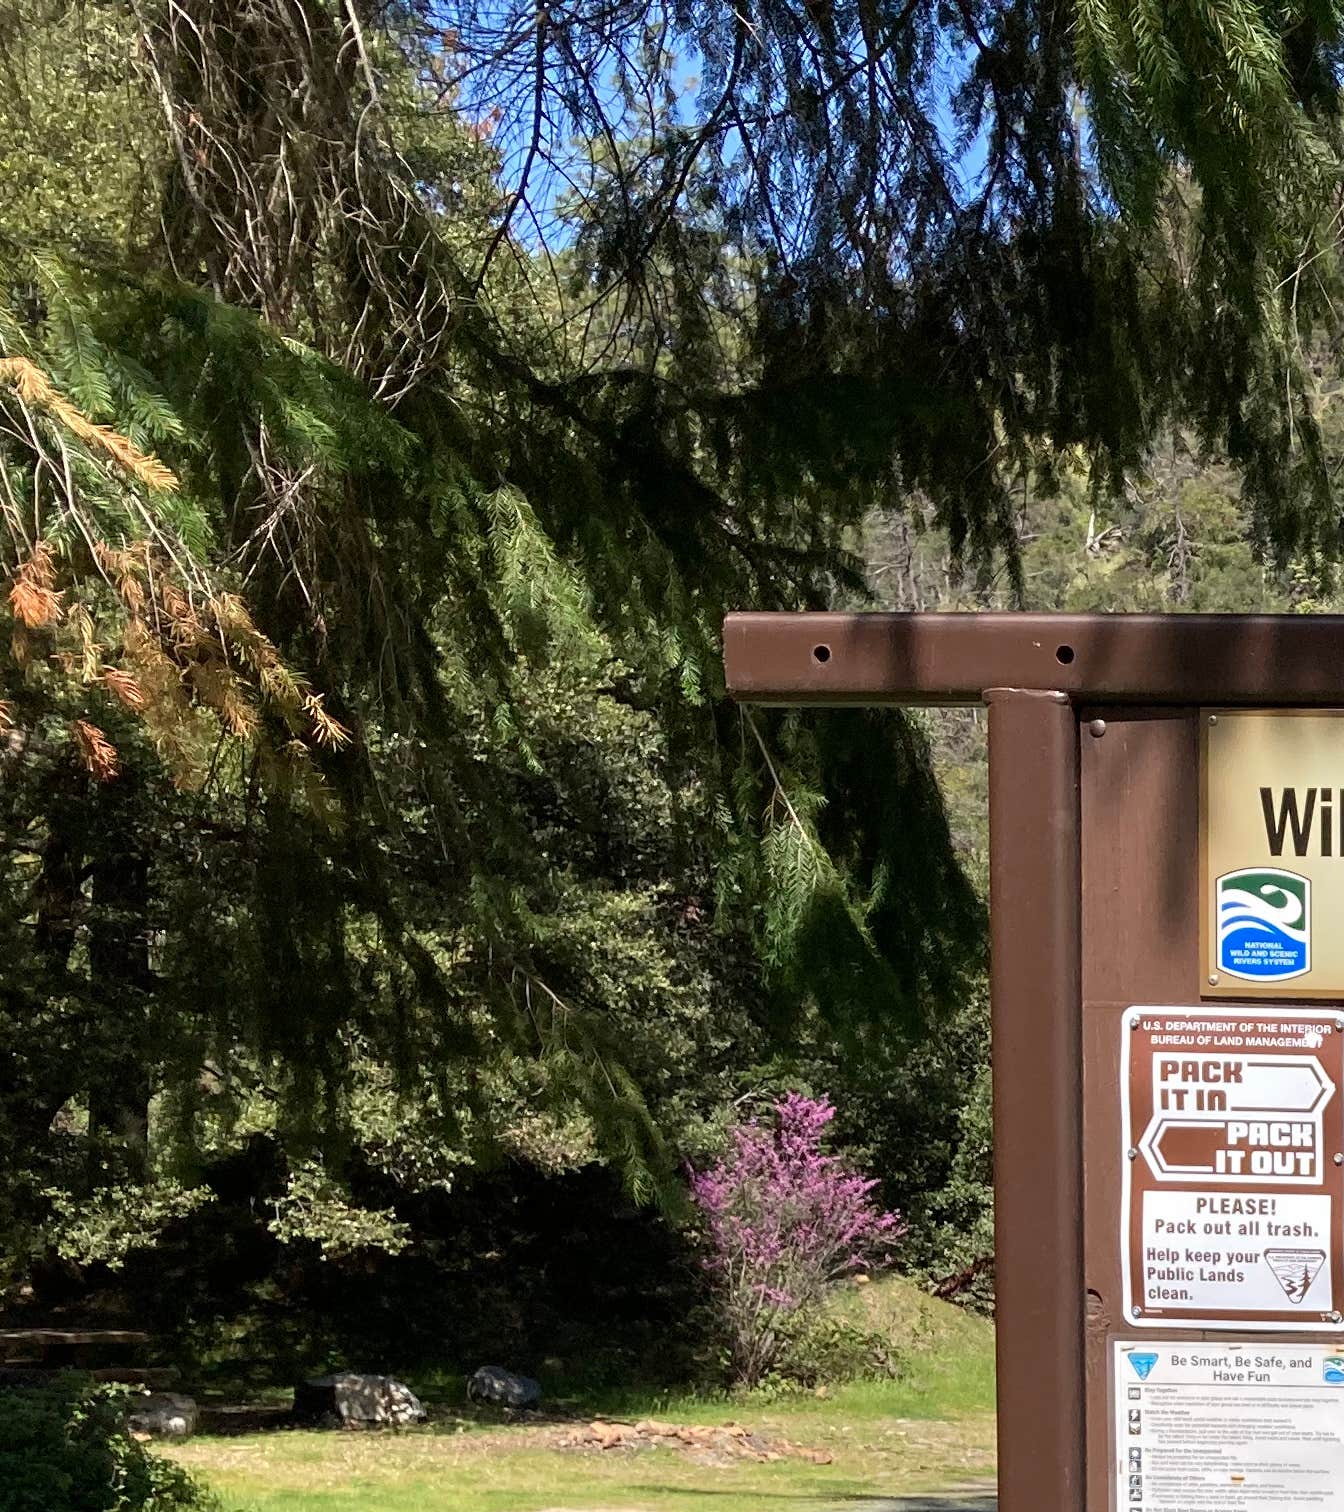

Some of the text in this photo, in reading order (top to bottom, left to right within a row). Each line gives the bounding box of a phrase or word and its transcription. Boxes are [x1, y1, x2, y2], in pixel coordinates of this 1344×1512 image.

[1270, 950, 1298, 958] SCENIC
[1143, 1021, 1163, 1031] U.S.
[1166, 1022, 1237, 1032] DEPARTMENT
[1240, 1023, 1253, 1032] OF
[1257, 1023, 1278, 1033] THE
[1151, 1035, 1194, 1045] BUREAU
[1197, 1036, 1212, 1046] OF
[1214, 1036, 1243, 1046] LAND
[1160, 1060, 1243, 1083] PACK
[1161, 1088, 1189, 1110] IT
[1227, 1122, 1313, 1147] PACK
[1216, 1150, 1314, 1175] IT OUT
[1196, 1198, 1276, 1215] PLEASE!
[1155, 1220, 1319, 1237] Pack out all trash.
[1147, 1248, 1180, 1264] Help
[1185, 1248, 1221, 1265] keep
[1227, 1252, 1260, 1266] your
[1148, 1267, 1245, 1282] Public Lands
[1148, 1286, 1194, 1300] clean.
[1171, 1355, 1312, 1370] Be Smart, Be Safe, and
[1213, 1371, 1270, 1382] Have Fun
